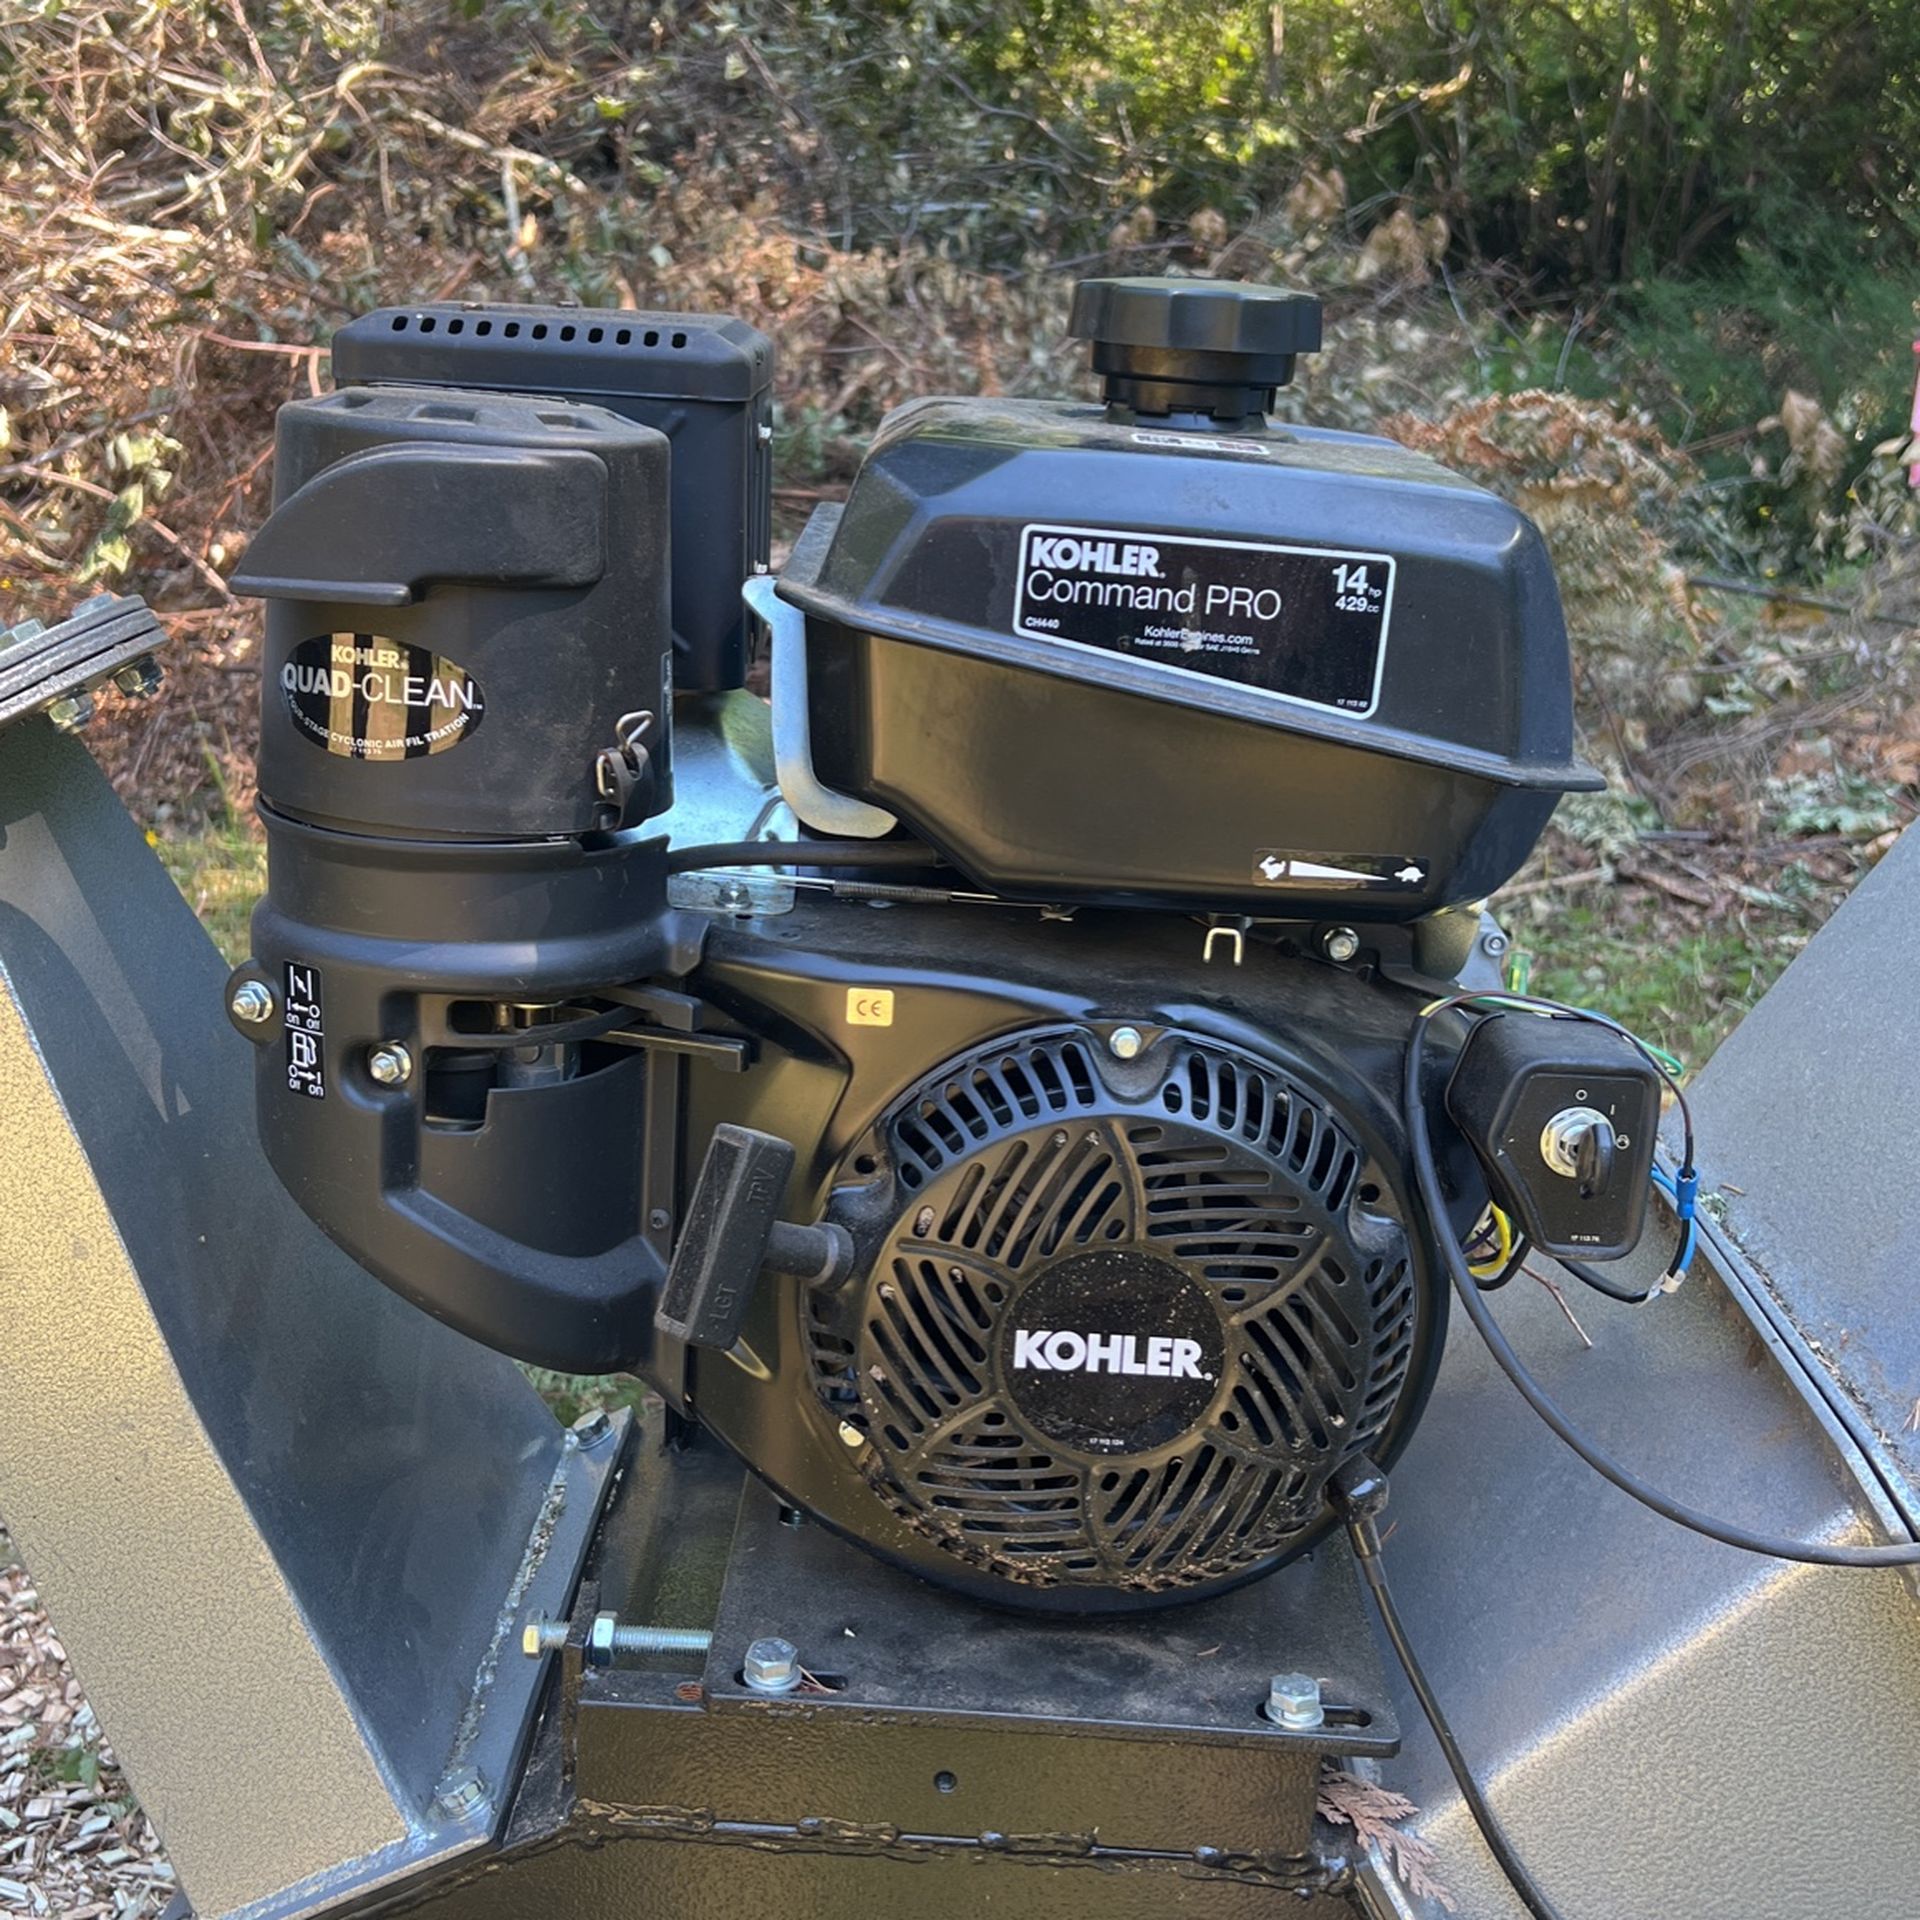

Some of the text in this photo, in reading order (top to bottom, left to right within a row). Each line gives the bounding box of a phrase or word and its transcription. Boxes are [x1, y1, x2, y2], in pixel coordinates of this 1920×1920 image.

[1027, 569, 1282, 620] Command PRO
[330, 732, 383, 749] CYCLONIC
[385, 739, 404, 749] AIR
[1013, 1329, 1206, 1380] KOHLER
